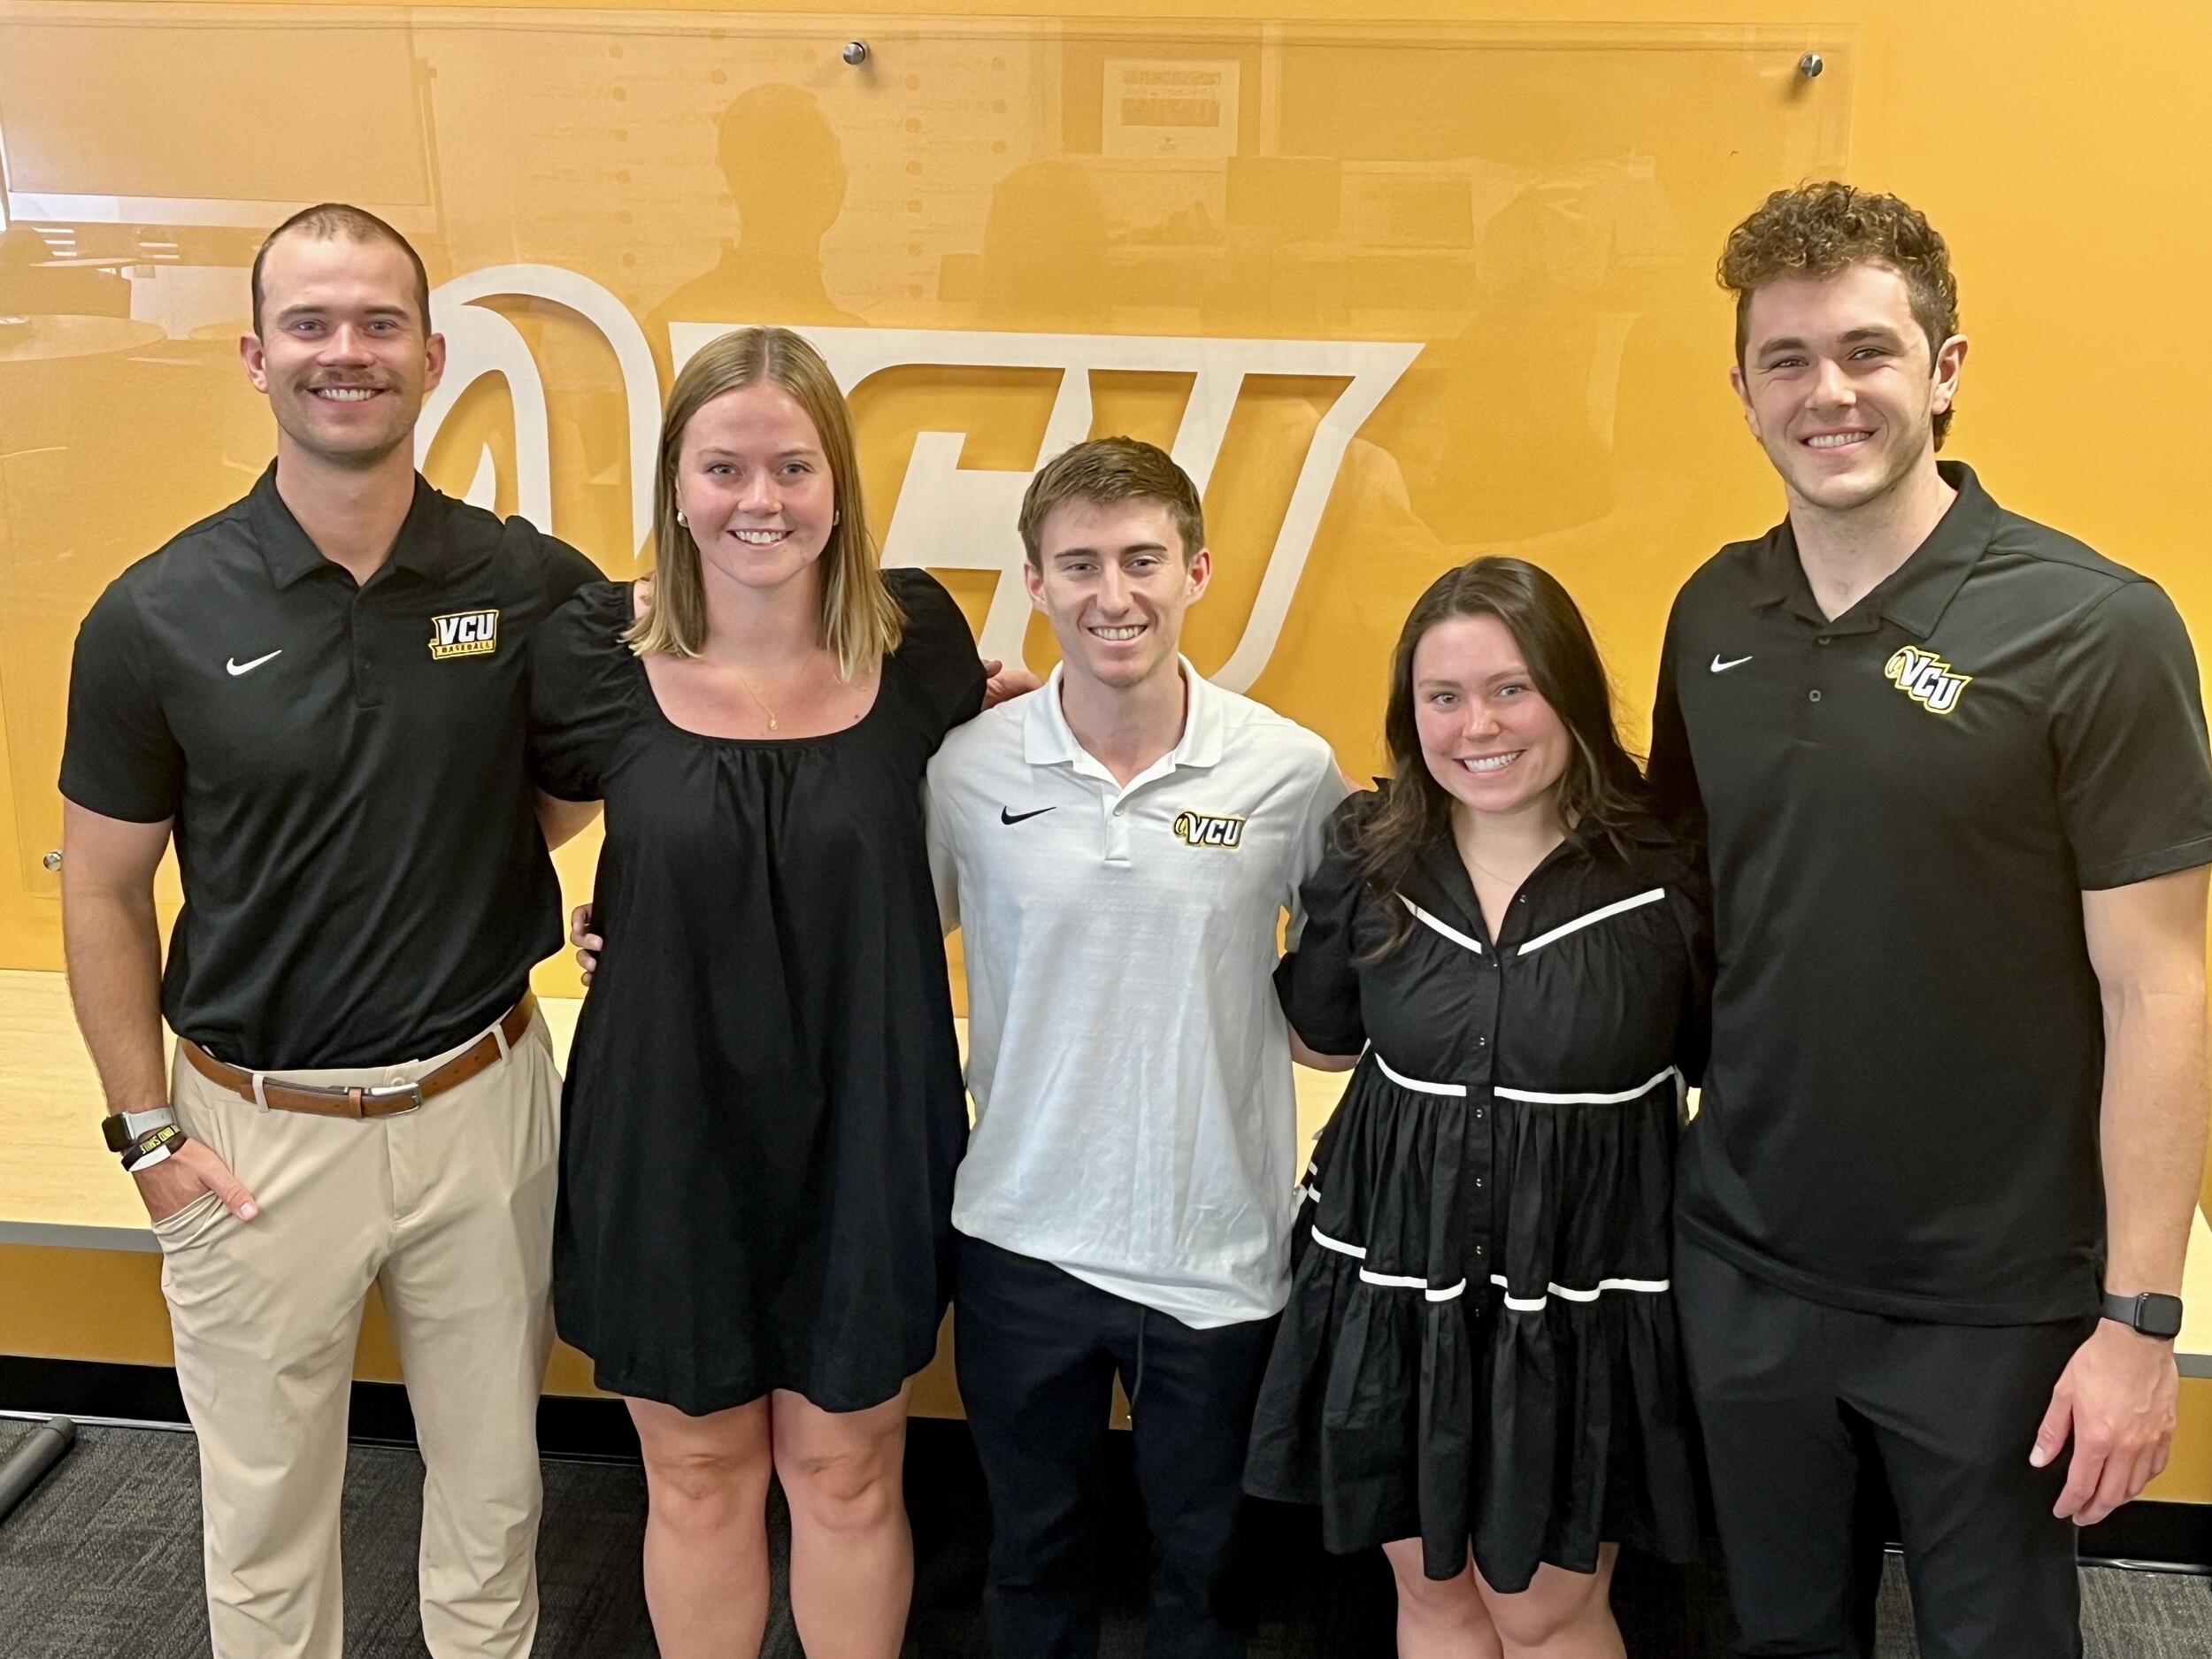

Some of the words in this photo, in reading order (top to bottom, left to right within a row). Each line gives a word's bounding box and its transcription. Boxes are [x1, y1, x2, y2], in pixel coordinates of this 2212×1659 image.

[437, 612, 495, 646] VCU
[441, 641, 492, 654] BASEBALL
[1888, 649, 1964, 710] VCU
[1173, 811, 1243, 846] VCU
